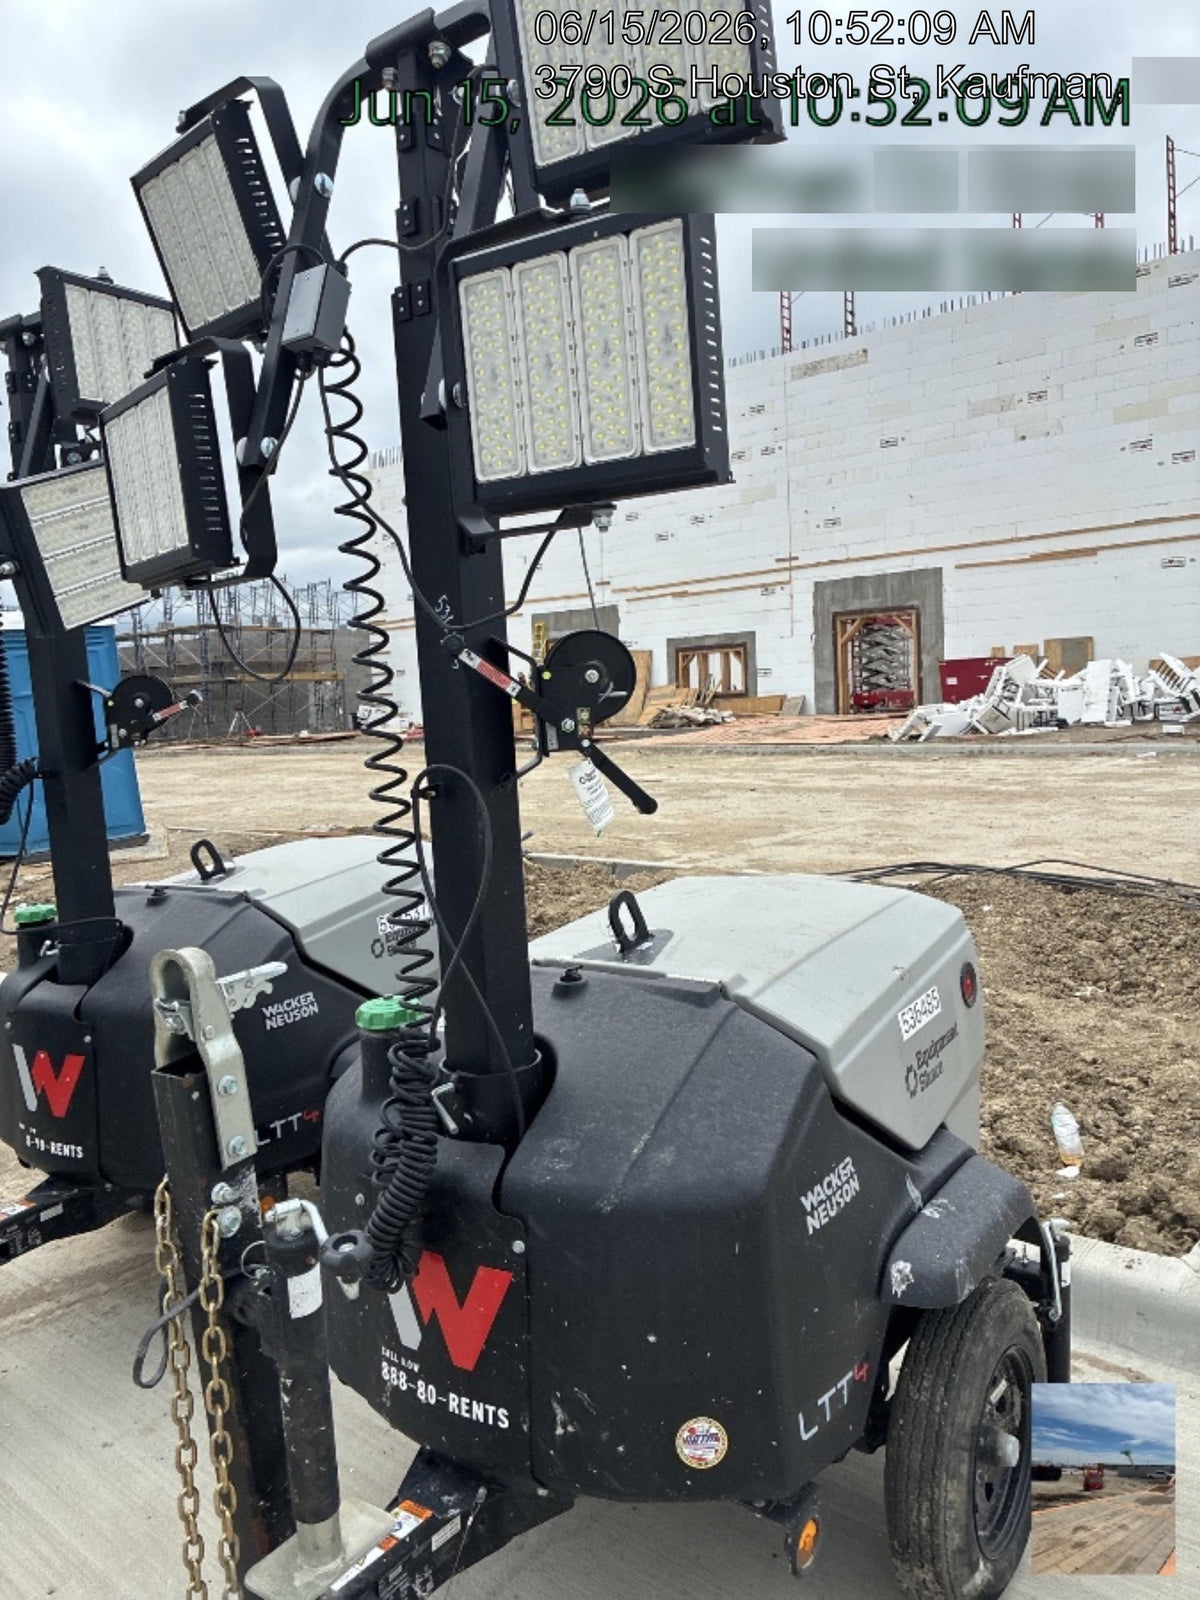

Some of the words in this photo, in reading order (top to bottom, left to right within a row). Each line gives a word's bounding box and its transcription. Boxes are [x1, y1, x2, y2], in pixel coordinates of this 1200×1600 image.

[261, 991, 316, 1018] WACKER
[266, 1002, 319, 1030] NEUSON
[901, 988, 940, 1034] 536485
[800, 1156, 856, 1212] WACKER
[806, 1173, 860, 1235] NEUSON
[381, 1361, 510, 1429] 888-80-RENTS
[798, 1361, 869, 1441] LTT4
